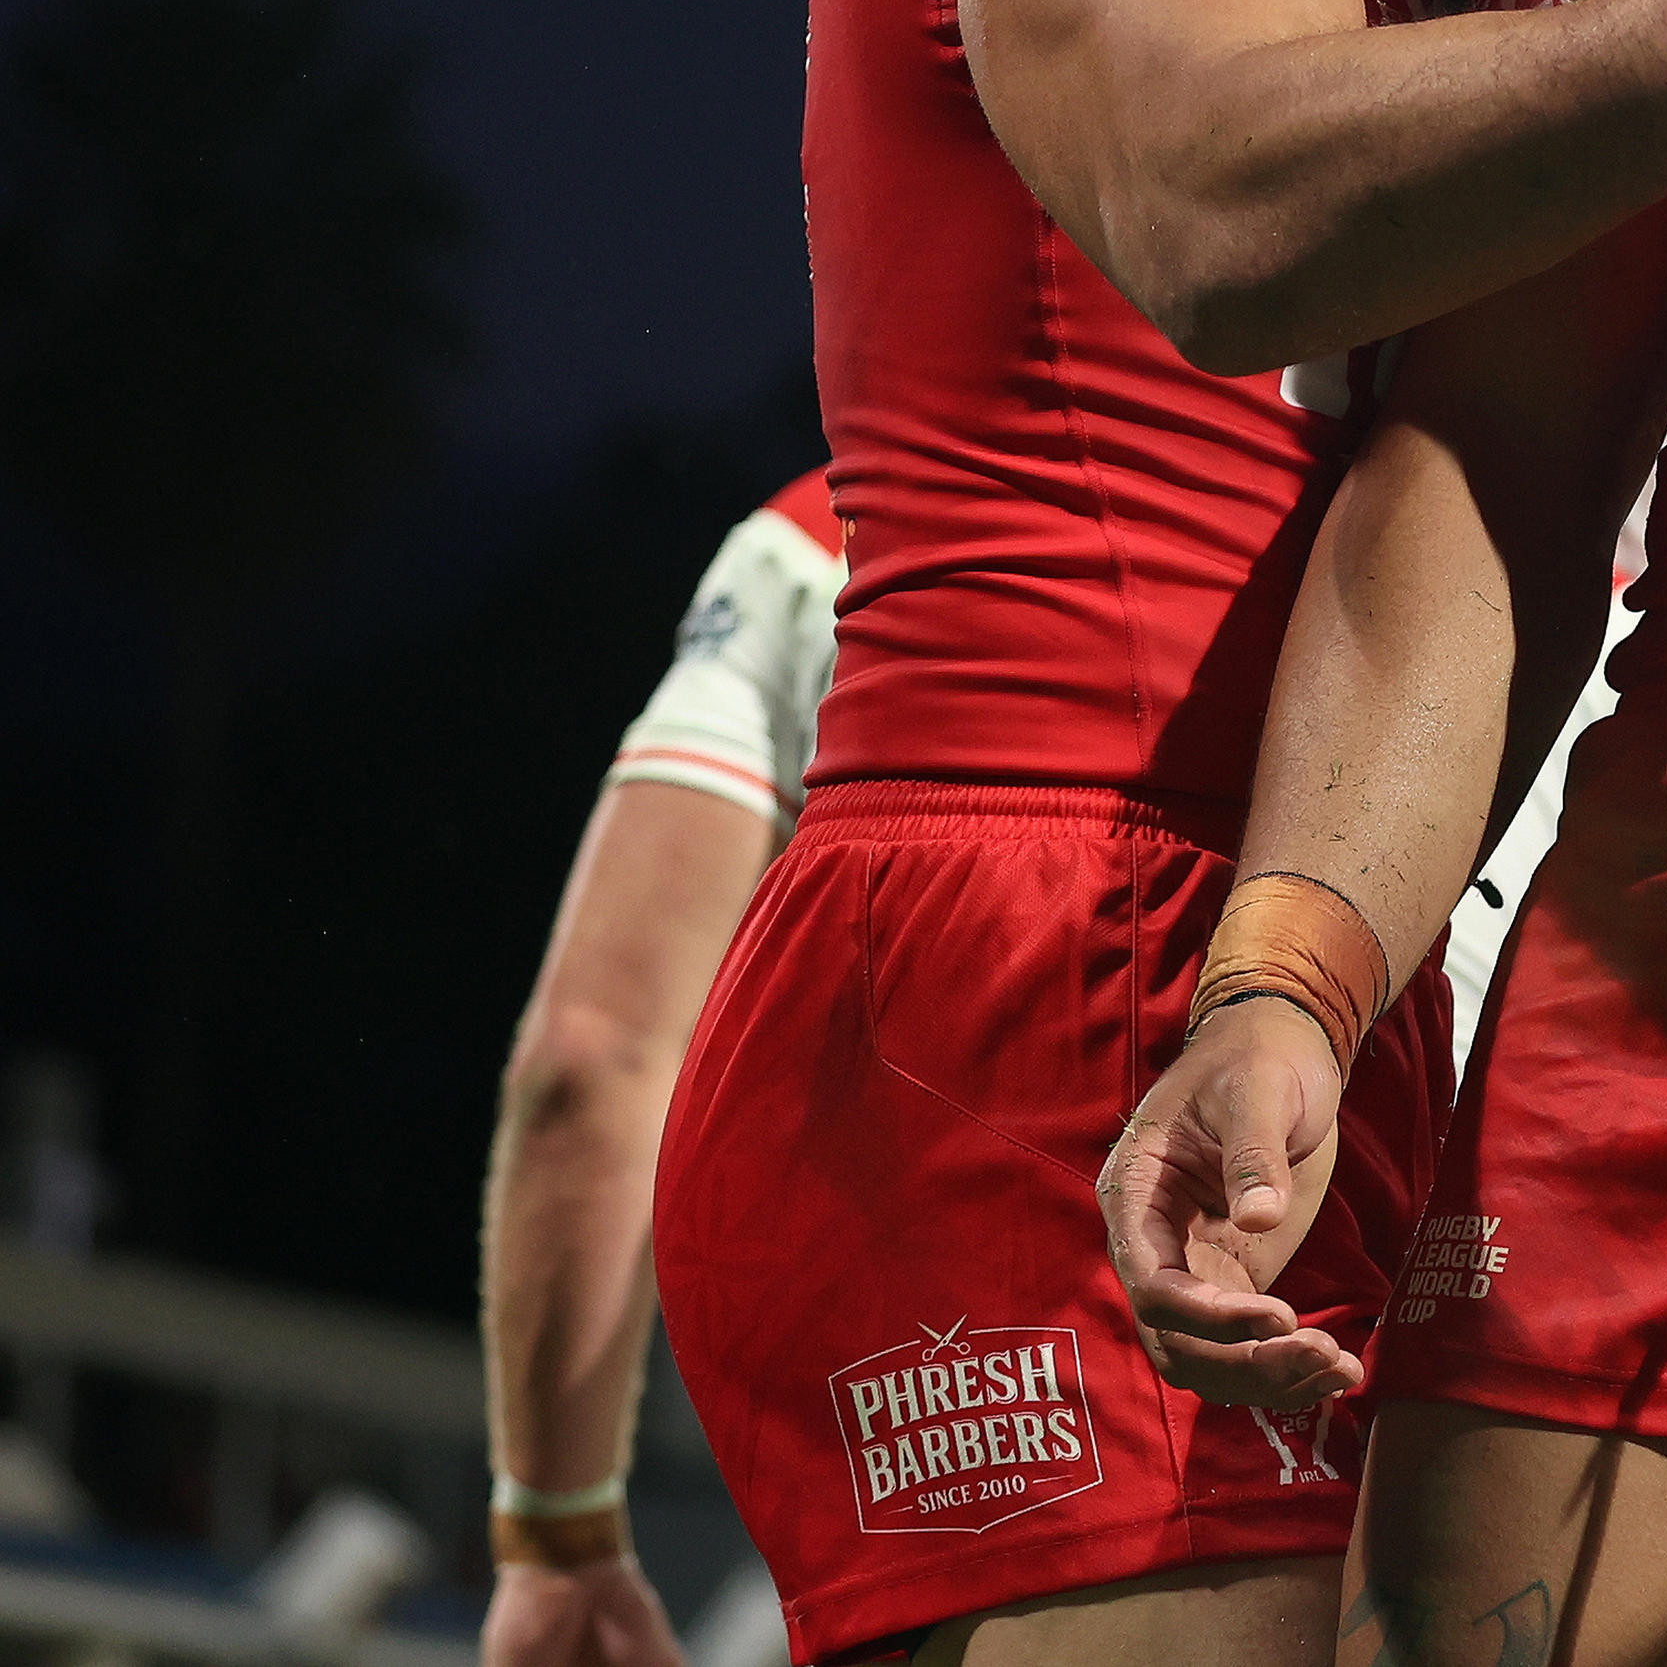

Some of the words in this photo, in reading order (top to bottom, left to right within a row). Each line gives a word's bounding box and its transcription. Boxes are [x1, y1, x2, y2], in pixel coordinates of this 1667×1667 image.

[1423, 1214, 1502, 1242] RUGBY
[1413, 1242, 1510, 1273] LEAGUE
[1406, 1270, 1492, 1299] WORLD
[1397, 1298, 1437, 1324] CUP
[846, 1342, 1065, 1443] PHRESH
[1281, 1414, 1310, 1434] 26
[861, 1407, 1082, 1505] BARBERS
[1298, 1469, 1325, 1484] IRL
[917, 1482, 974, 1514] SINCE
[976, 1474, 1026, 1501] 2010
